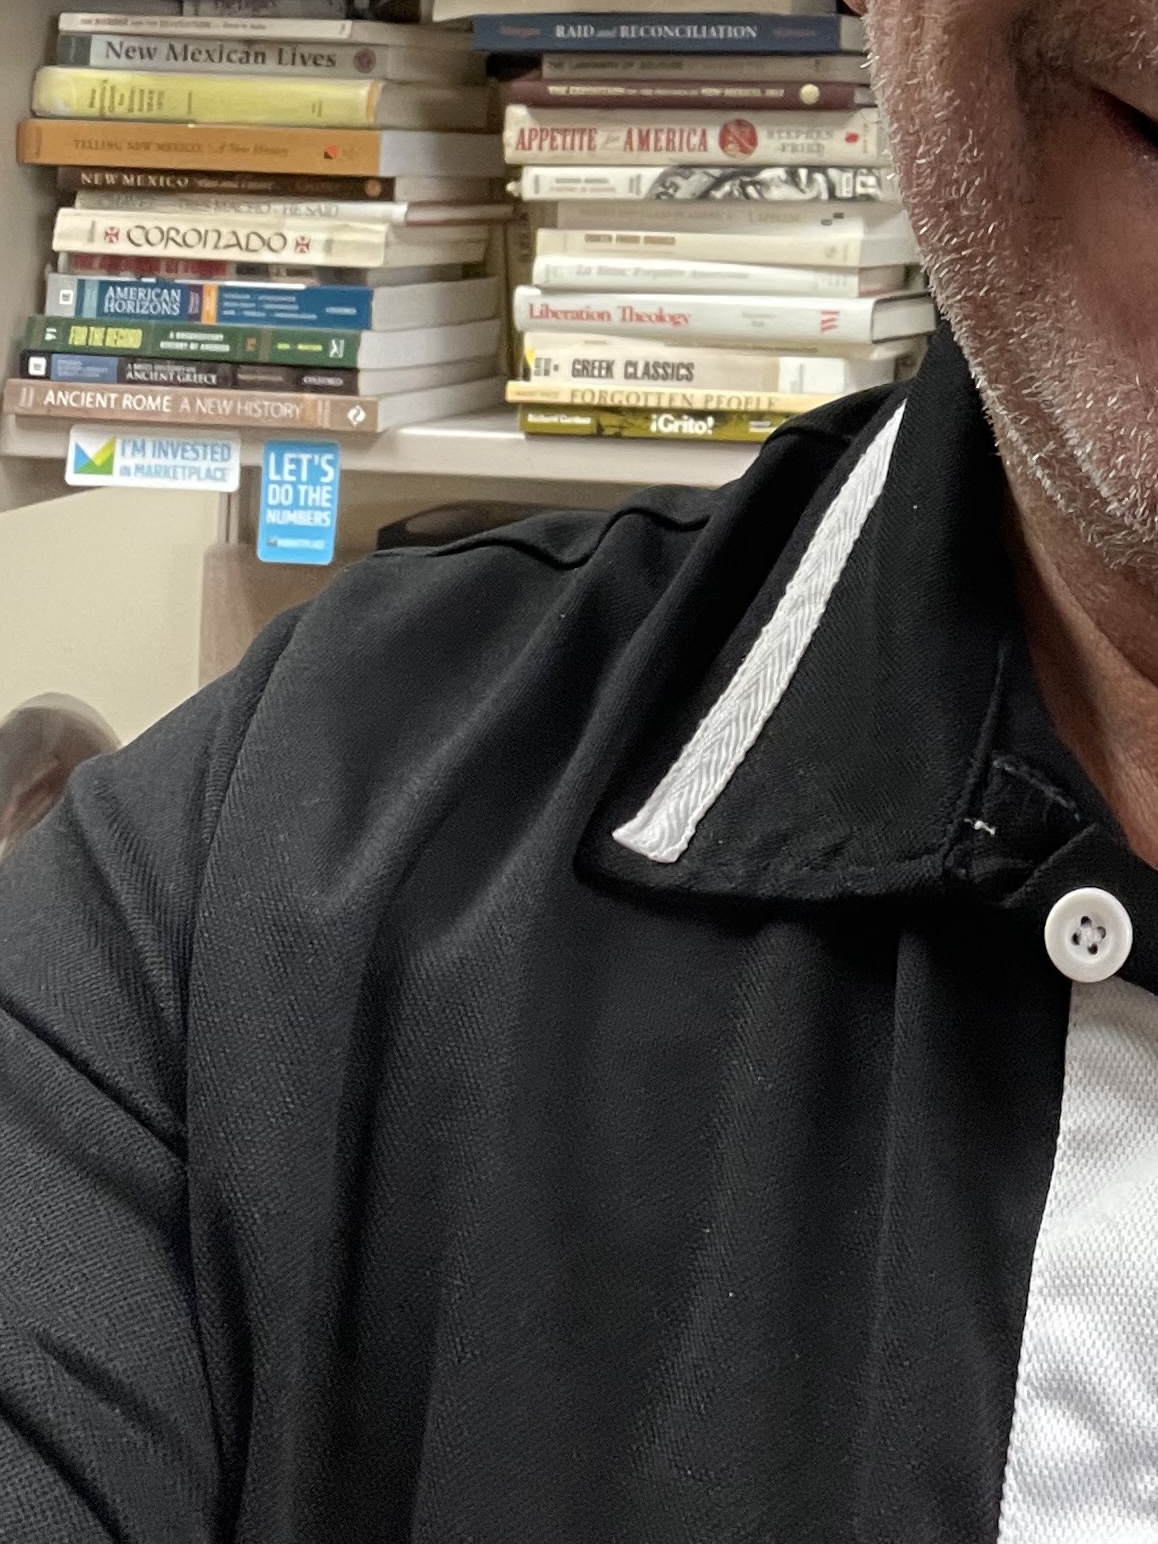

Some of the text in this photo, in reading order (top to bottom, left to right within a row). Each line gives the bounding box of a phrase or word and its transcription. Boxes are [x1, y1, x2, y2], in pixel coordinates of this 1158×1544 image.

[555, 24, 595, 39] RAID
[620, 24, 758, 40] RECONCILIATION
[105, 40, 337, 68] New Mexican Lives
[515, 127, 597, 152] APPETITE
[623, 127, 708, 153] AMERICA
[80, 172, 117, 186] NEW
[121, 173, 190, 188] MEXICO
[126, 224, 287, 253] CORONADO
[104, 285, 182, 303] AMERICAN
[103, 296, 181, 316] HORIZONS
[528, 302, 692, 328] Liberation Theology
[125, 371, 175, 382] ANCIENT
[571, 358, 616, 381] GREEK
[624, 360, 696, 383] CLASSICS
[43, 389, 303, 421] ANCIENT ROME A NEW HISTORY
[569, 387, 695, 407] FORGOTTEN
[702, 393, 778, 410] PEOPLE
[650, 413, 715, 435] ¡Grito!
[120, 438, 232, 462] I'M INVESTED
[134, 464, 229, 483] MARKETPLACE
[267, 452, 335, 482] LET'S
[267, 483, 333, 508] DO THE
[266, 508, 332, 528] NUMBERS
